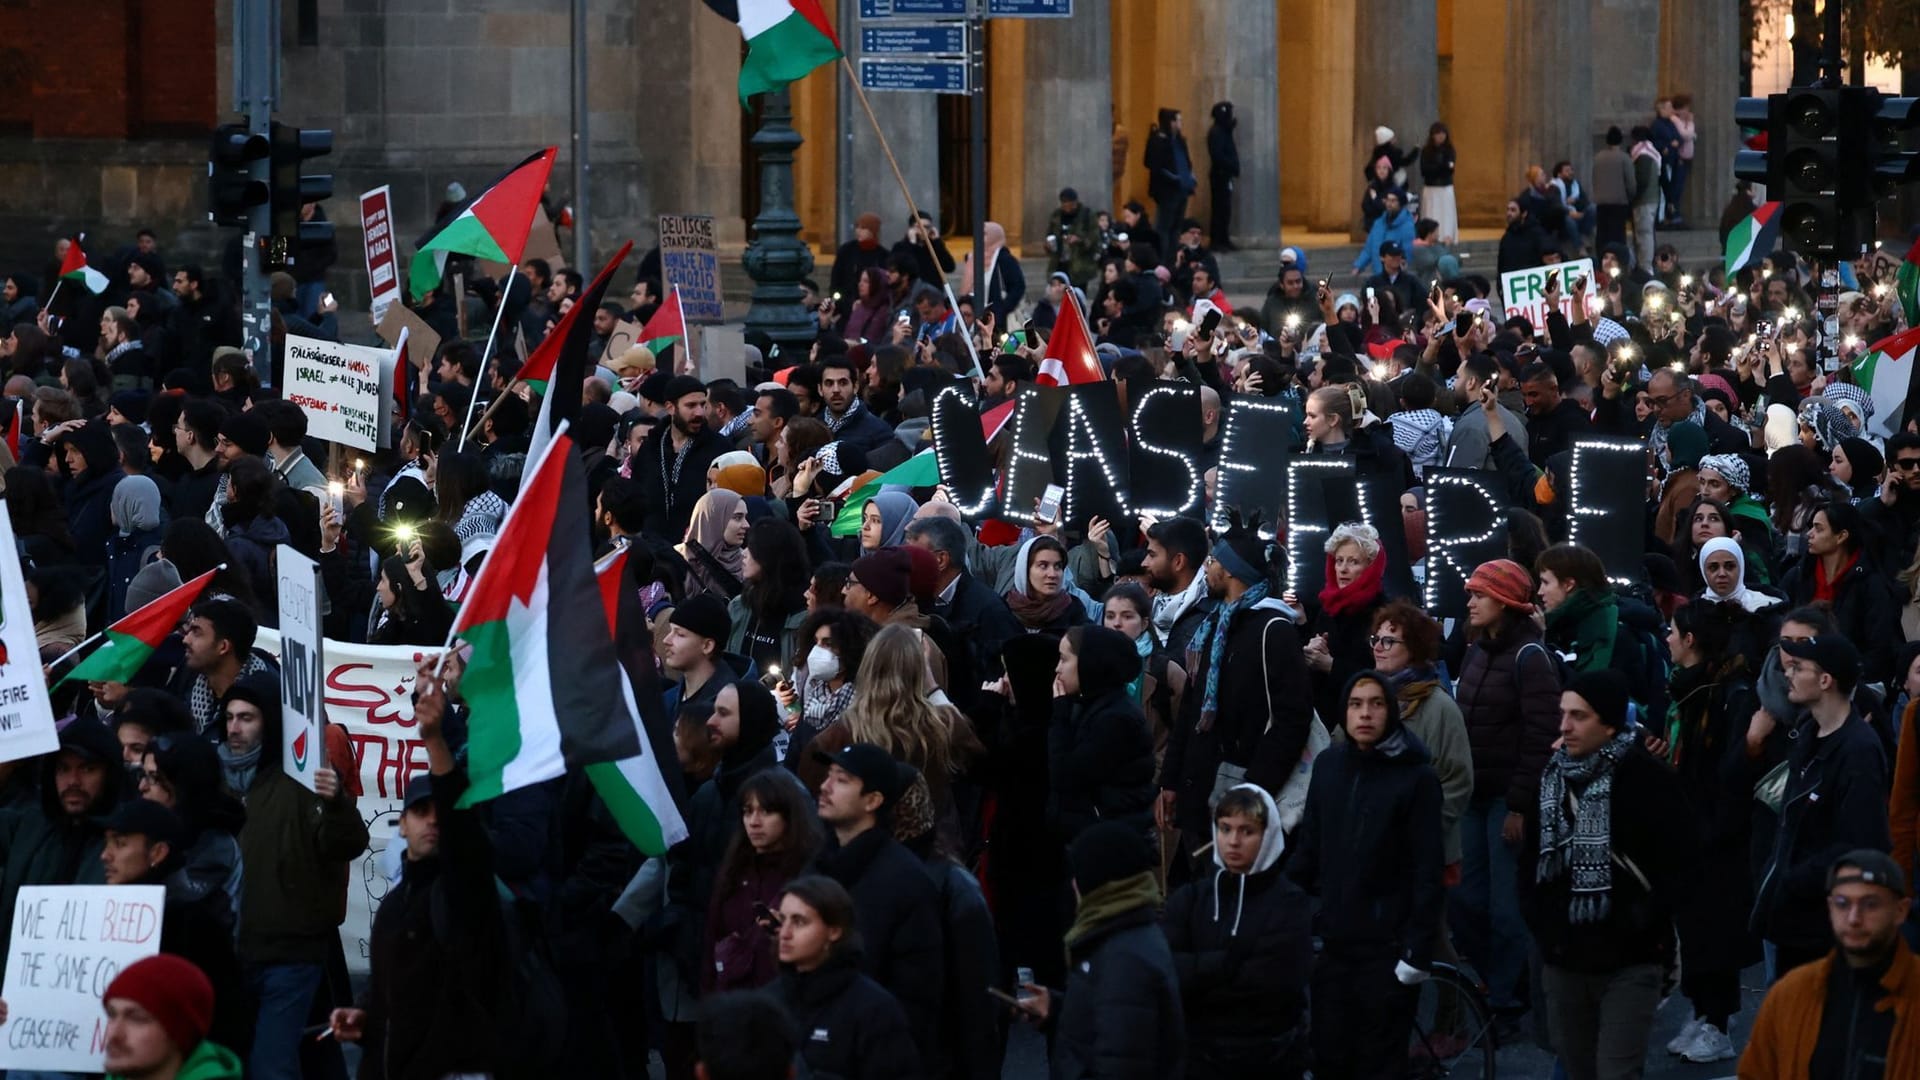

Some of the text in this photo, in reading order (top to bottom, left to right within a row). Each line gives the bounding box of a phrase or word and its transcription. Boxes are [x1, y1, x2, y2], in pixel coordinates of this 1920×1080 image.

[661, 217, 712, 237] DEUTSCHE
[667, 268, 715, 289] GENOZID
[1509, 265, 1580, 304] FRE
[296, 367, 326, 384] ISRAEL
[340, 374, 355, 388] ALLE
[347, 359, 370, 377] HAMAS
[340, 405, 374, 424] MENSCHEN
[345, 419, 377, 442] RECHTE
[20, 898, 157, 944] WE ALL BLEED
[19, 952, 121, 999] THE SAME CO
[90, 1017, 108, 1055] N
